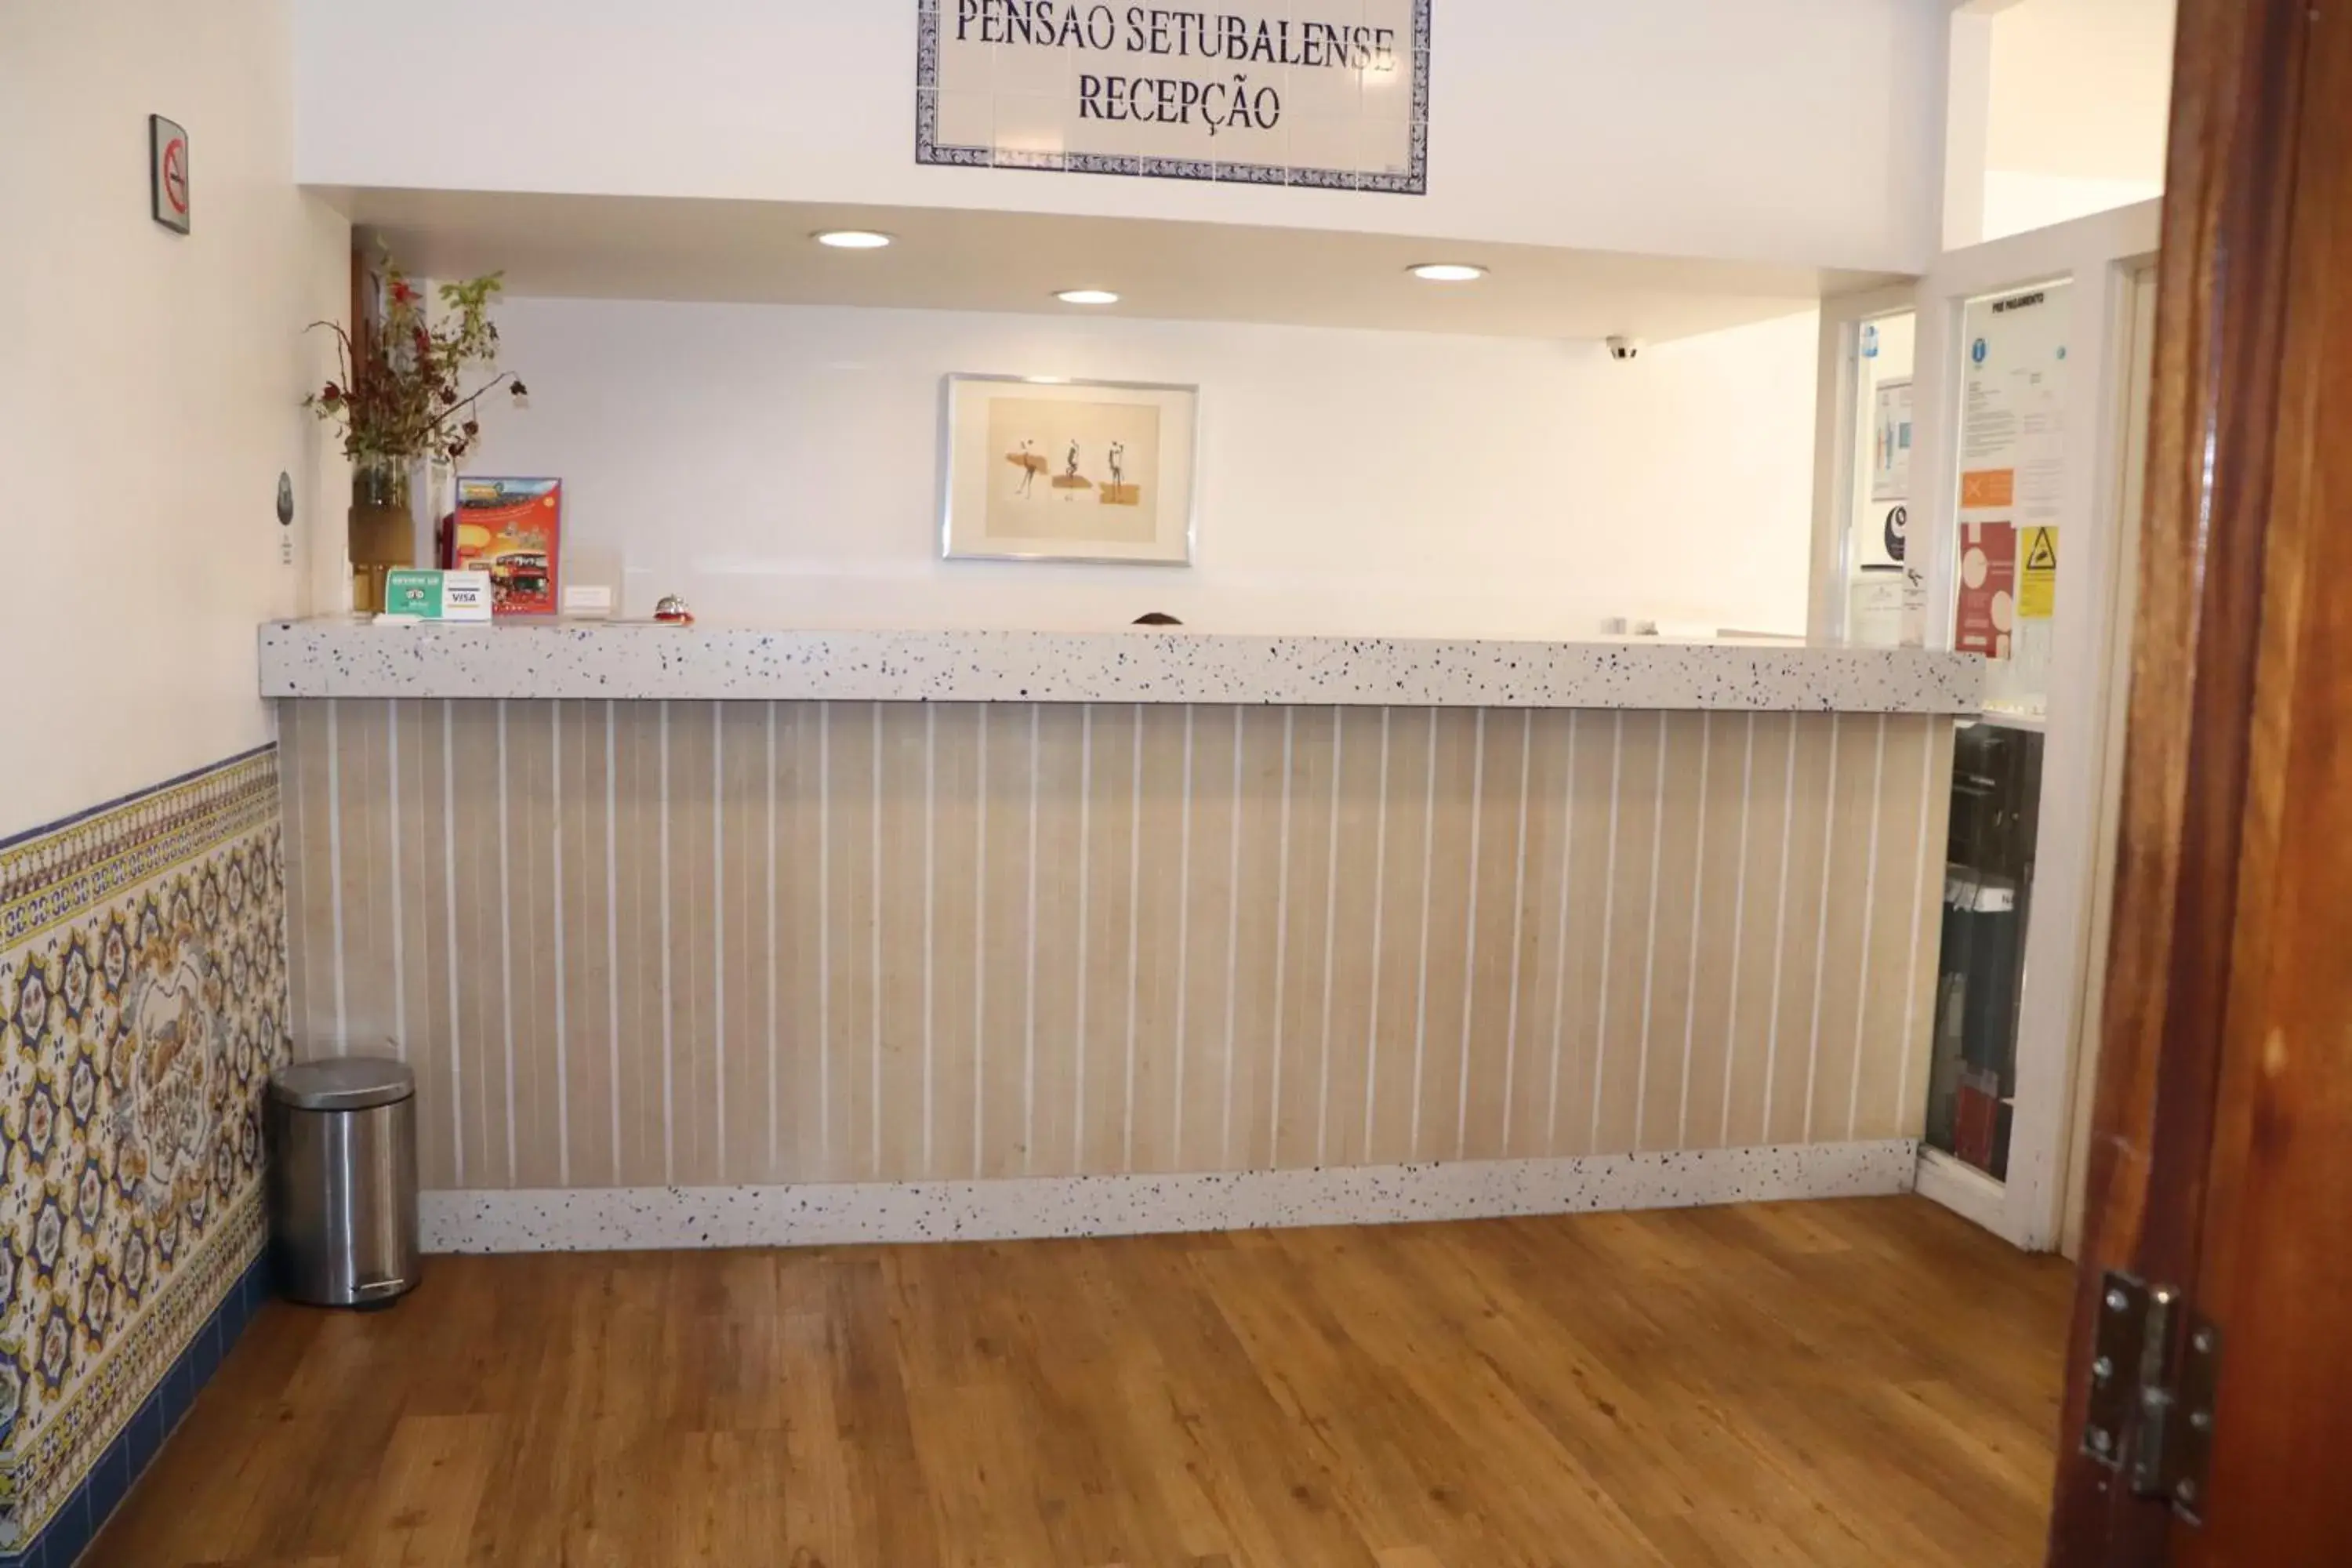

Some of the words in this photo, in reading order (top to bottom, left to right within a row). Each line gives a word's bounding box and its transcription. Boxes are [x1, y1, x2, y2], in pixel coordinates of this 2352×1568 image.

[1127, 7, 1395, 71] SETUBALENSE
[1079, 74, 1279, 136] RECEPÇÃO
[452, 593, 476, 602] VISA
